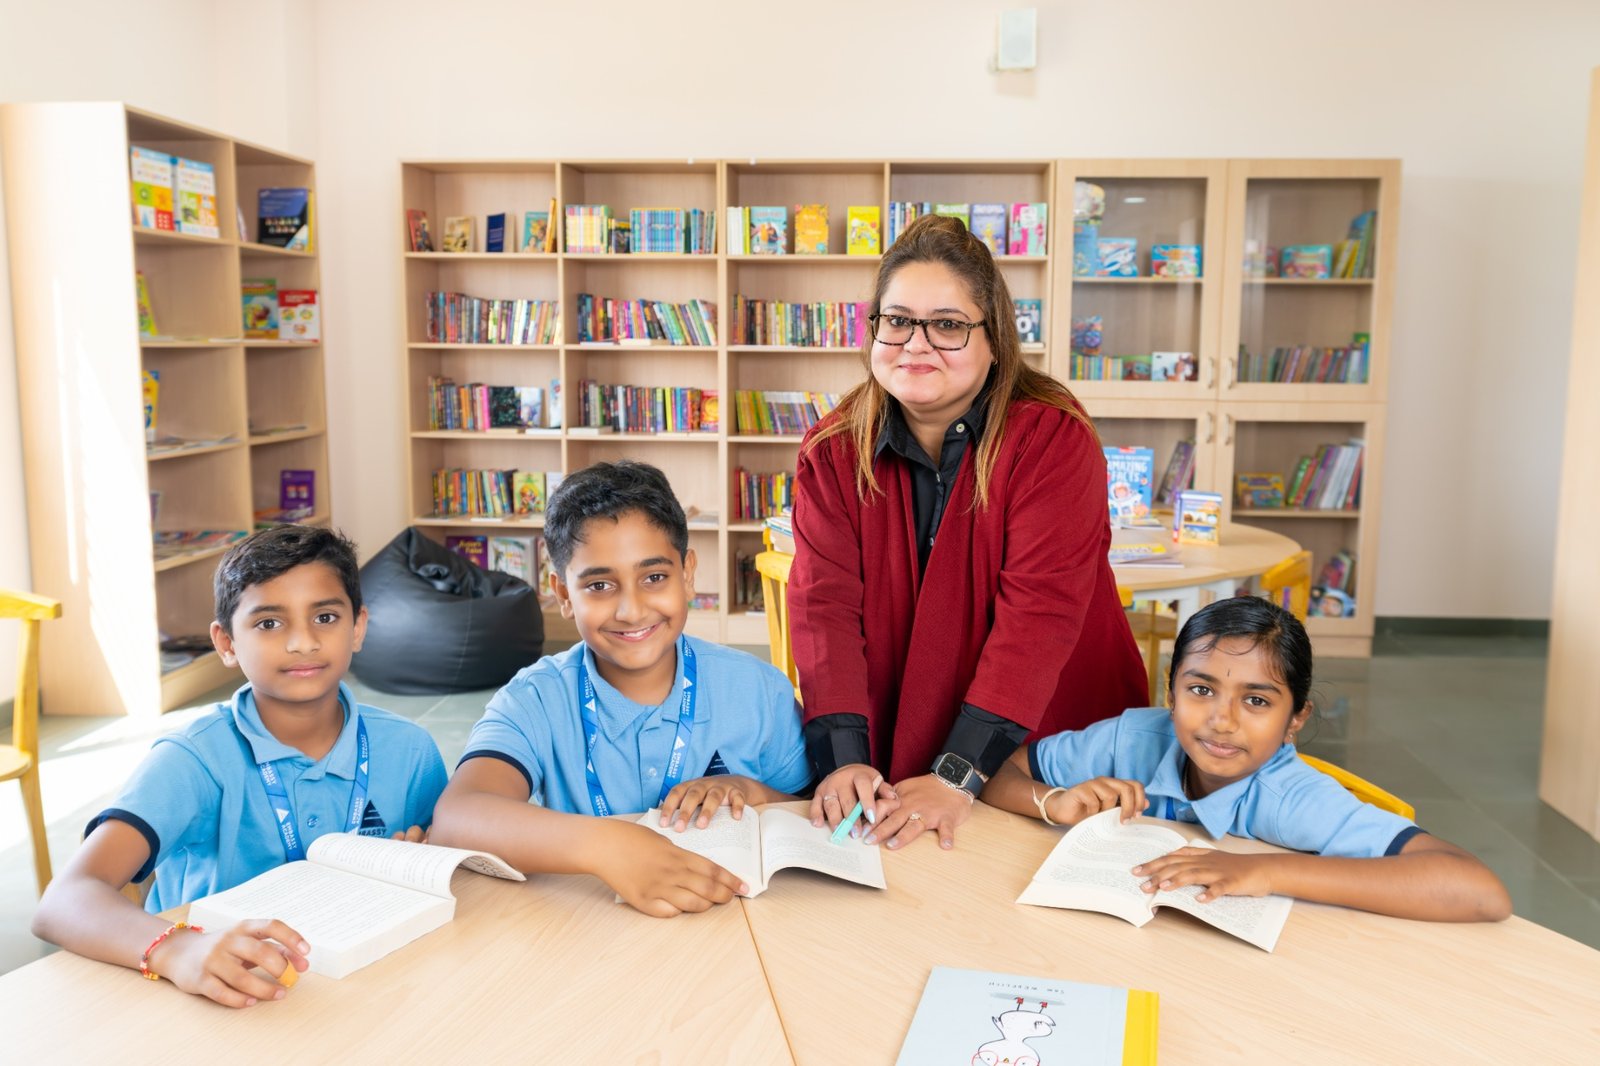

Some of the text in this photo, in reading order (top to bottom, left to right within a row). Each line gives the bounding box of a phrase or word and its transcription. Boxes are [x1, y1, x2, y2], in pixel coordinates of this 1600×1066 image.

[1110, 471, 1140, 483] FACTS
[672, 752, 681, 778] EMBASSY
[351, 797, 360, 824] EMBASSY
[356, 798, 364, 824] ACADEMY
[281, 824, 292, 850] ACADEMY
[285, 822, 297, 849] EMBASSY
